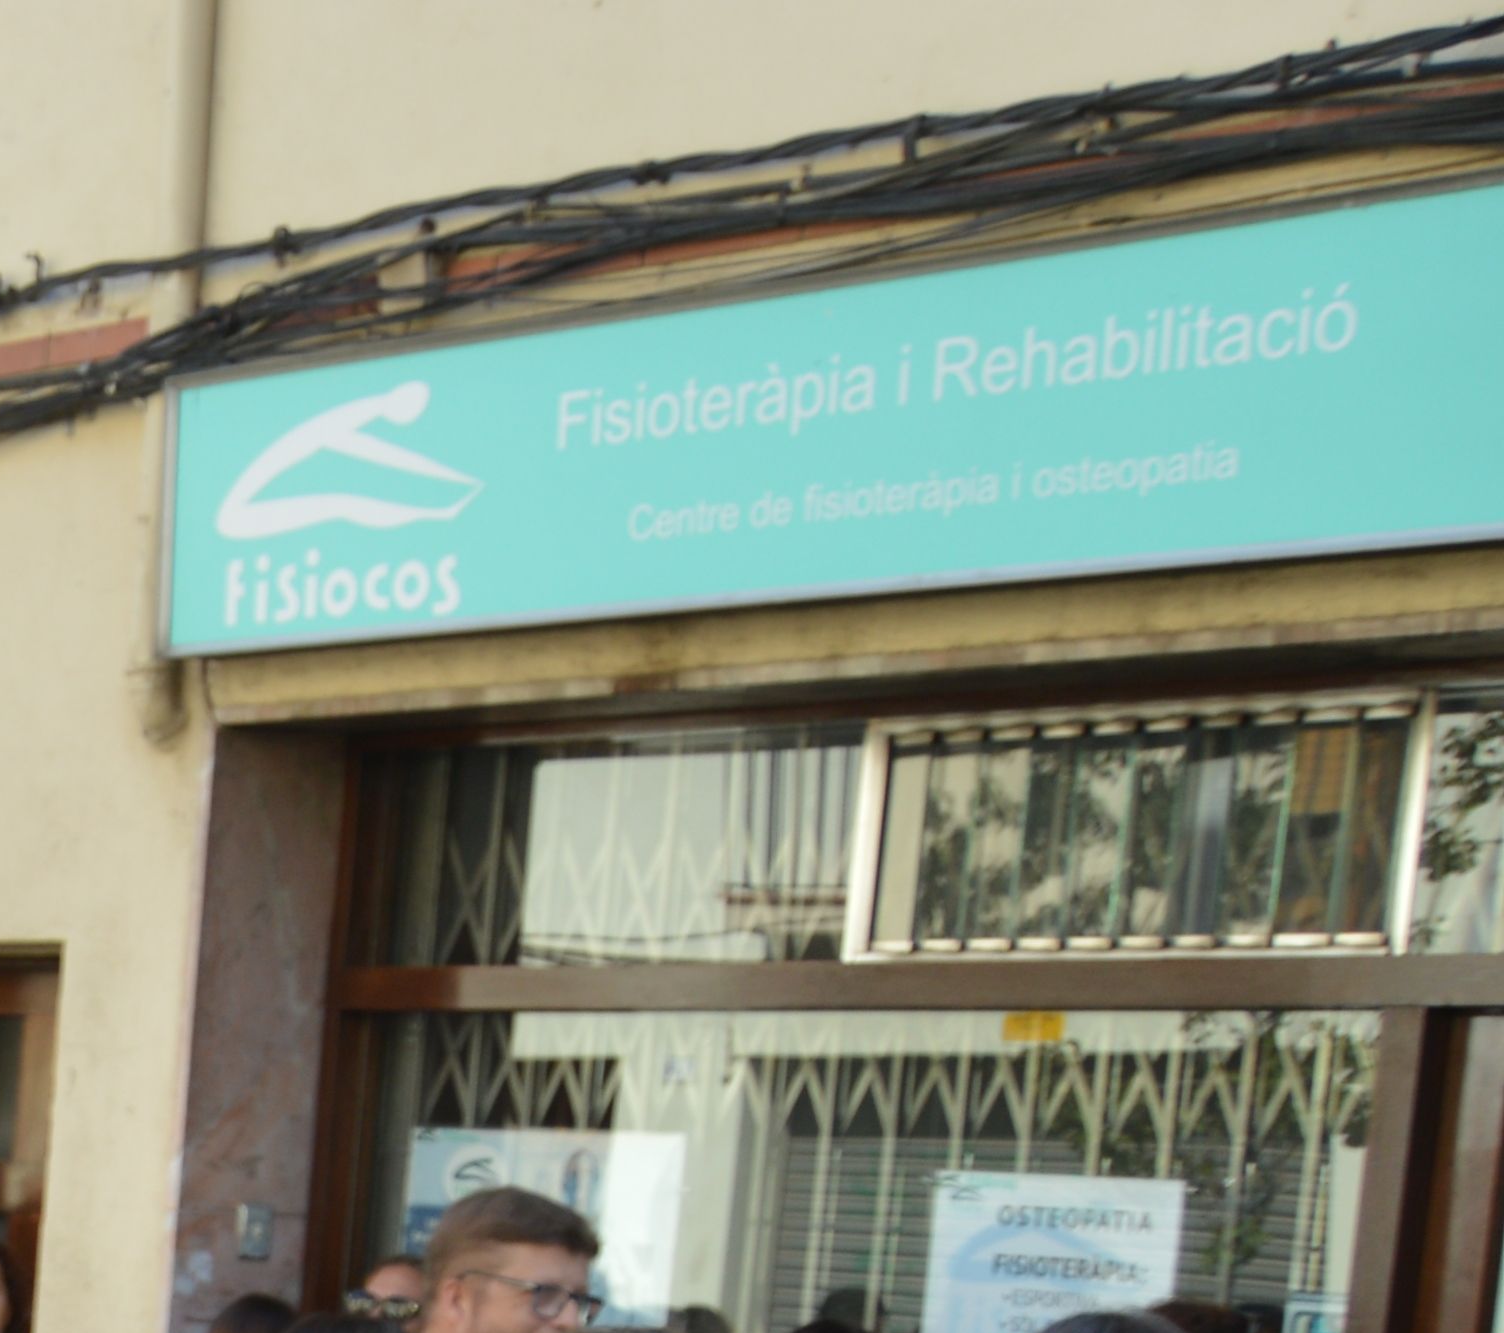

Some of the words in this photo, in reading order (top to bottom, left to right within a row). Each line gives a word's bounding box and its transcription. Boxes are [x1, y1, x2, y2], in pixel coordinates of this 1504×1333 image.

[555, 353, 876, 450] Fisioteràpia
[896, 343, 912, 406] i
[931, 282, 1358, 401] Rehabilitació
[626, 498, 740, 543] Centre
[747, 490, 794, 529] de
[803, 465, 1000, 524] fisioteràpia
[1009, 461, 1023, 500] i
[1031, 439, 1240, 497] osteopatia
[996, 1204, 1153, 1233] OSTEOPATIA
